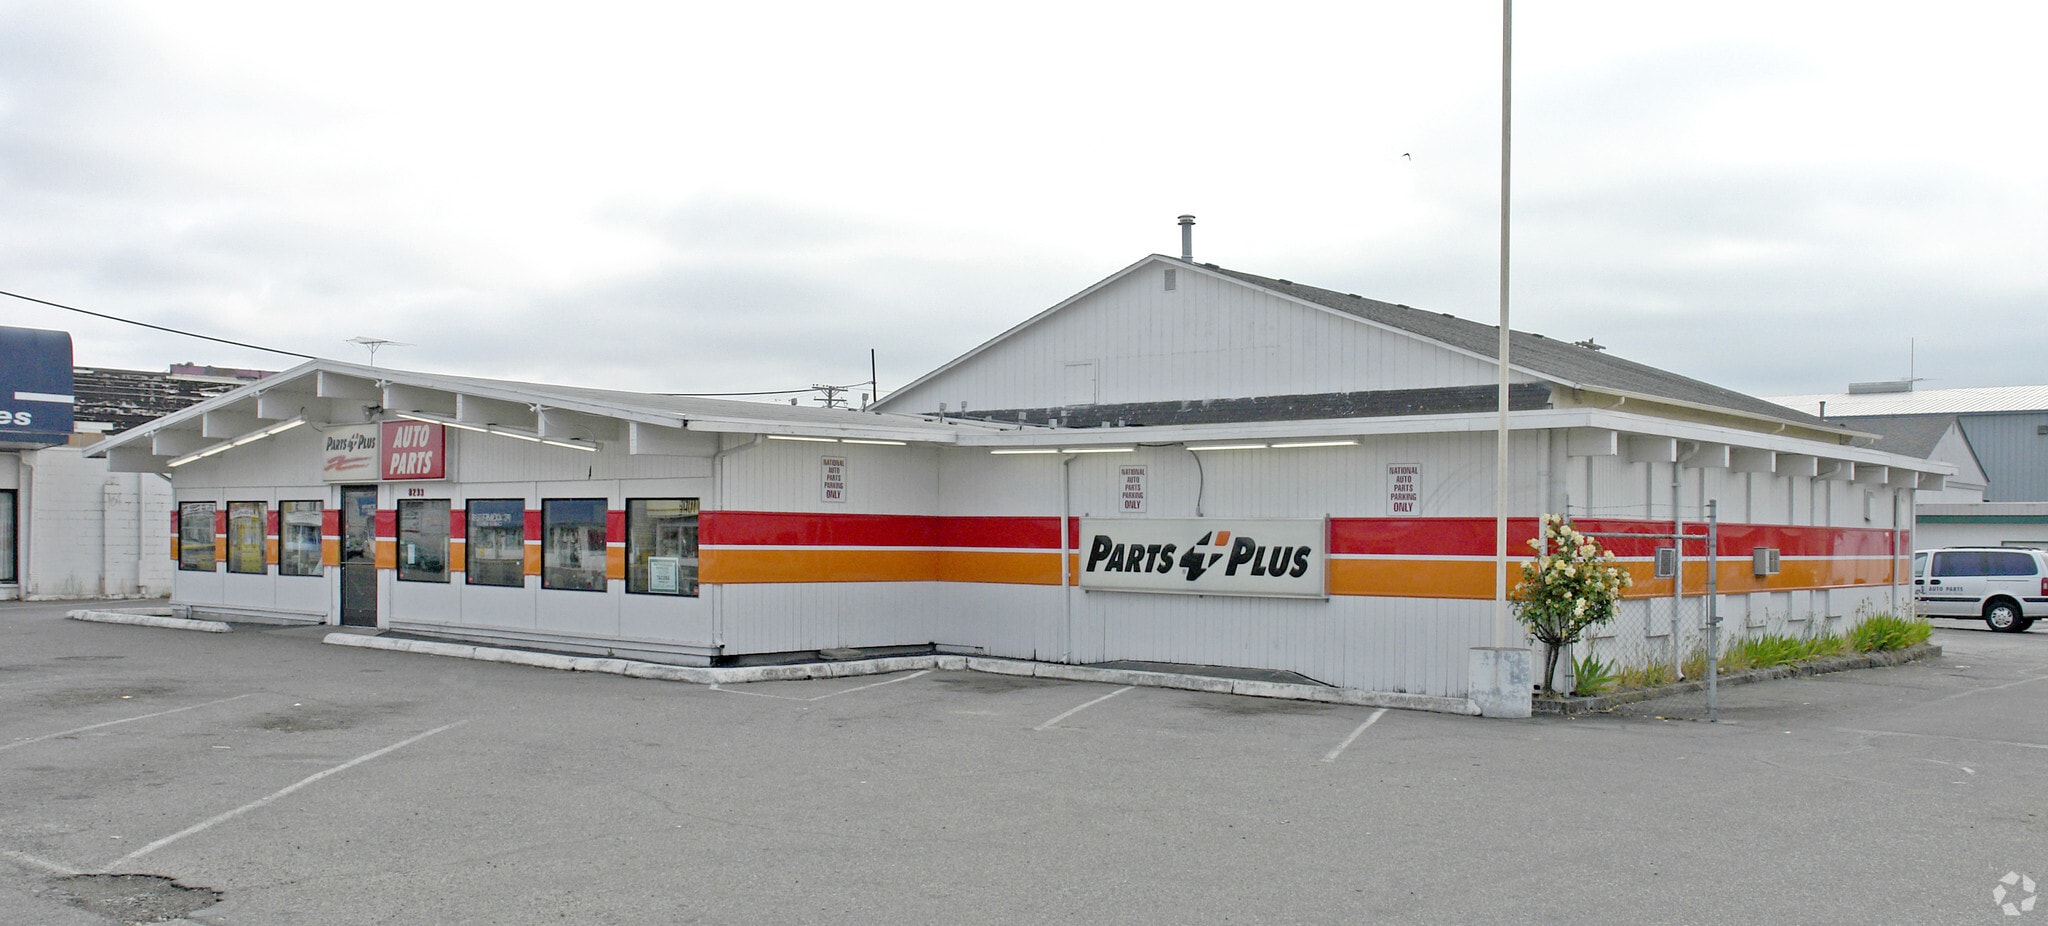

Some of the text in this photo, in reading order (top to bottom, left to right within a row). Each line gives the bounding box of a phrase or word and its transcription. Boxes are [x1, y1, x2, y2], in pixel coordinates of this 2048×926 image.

[392, 424, 430, 449] AUTO
[357, 434, 376, 450] PLUS
[389, 450, 433, 475] PARTS
[1121, 468, 1145, 476] NATIONAL
[1389, 466, 1418, 475] NATIONAL
[1127, 476, 1140, 484] AUTO
[1396, 475, 1412, 484] AUTO
[1394, 484, 1413, 493] PARTS
[826, 490, 841, 499] ONLY
[1390, 492, 1417, 501] PARKING
[1125, 500, 1141, 509] ONLY
[1393, 502, 1413, 513] ONLY
[1086, 535, 1312, 578] PARTS PLUS
